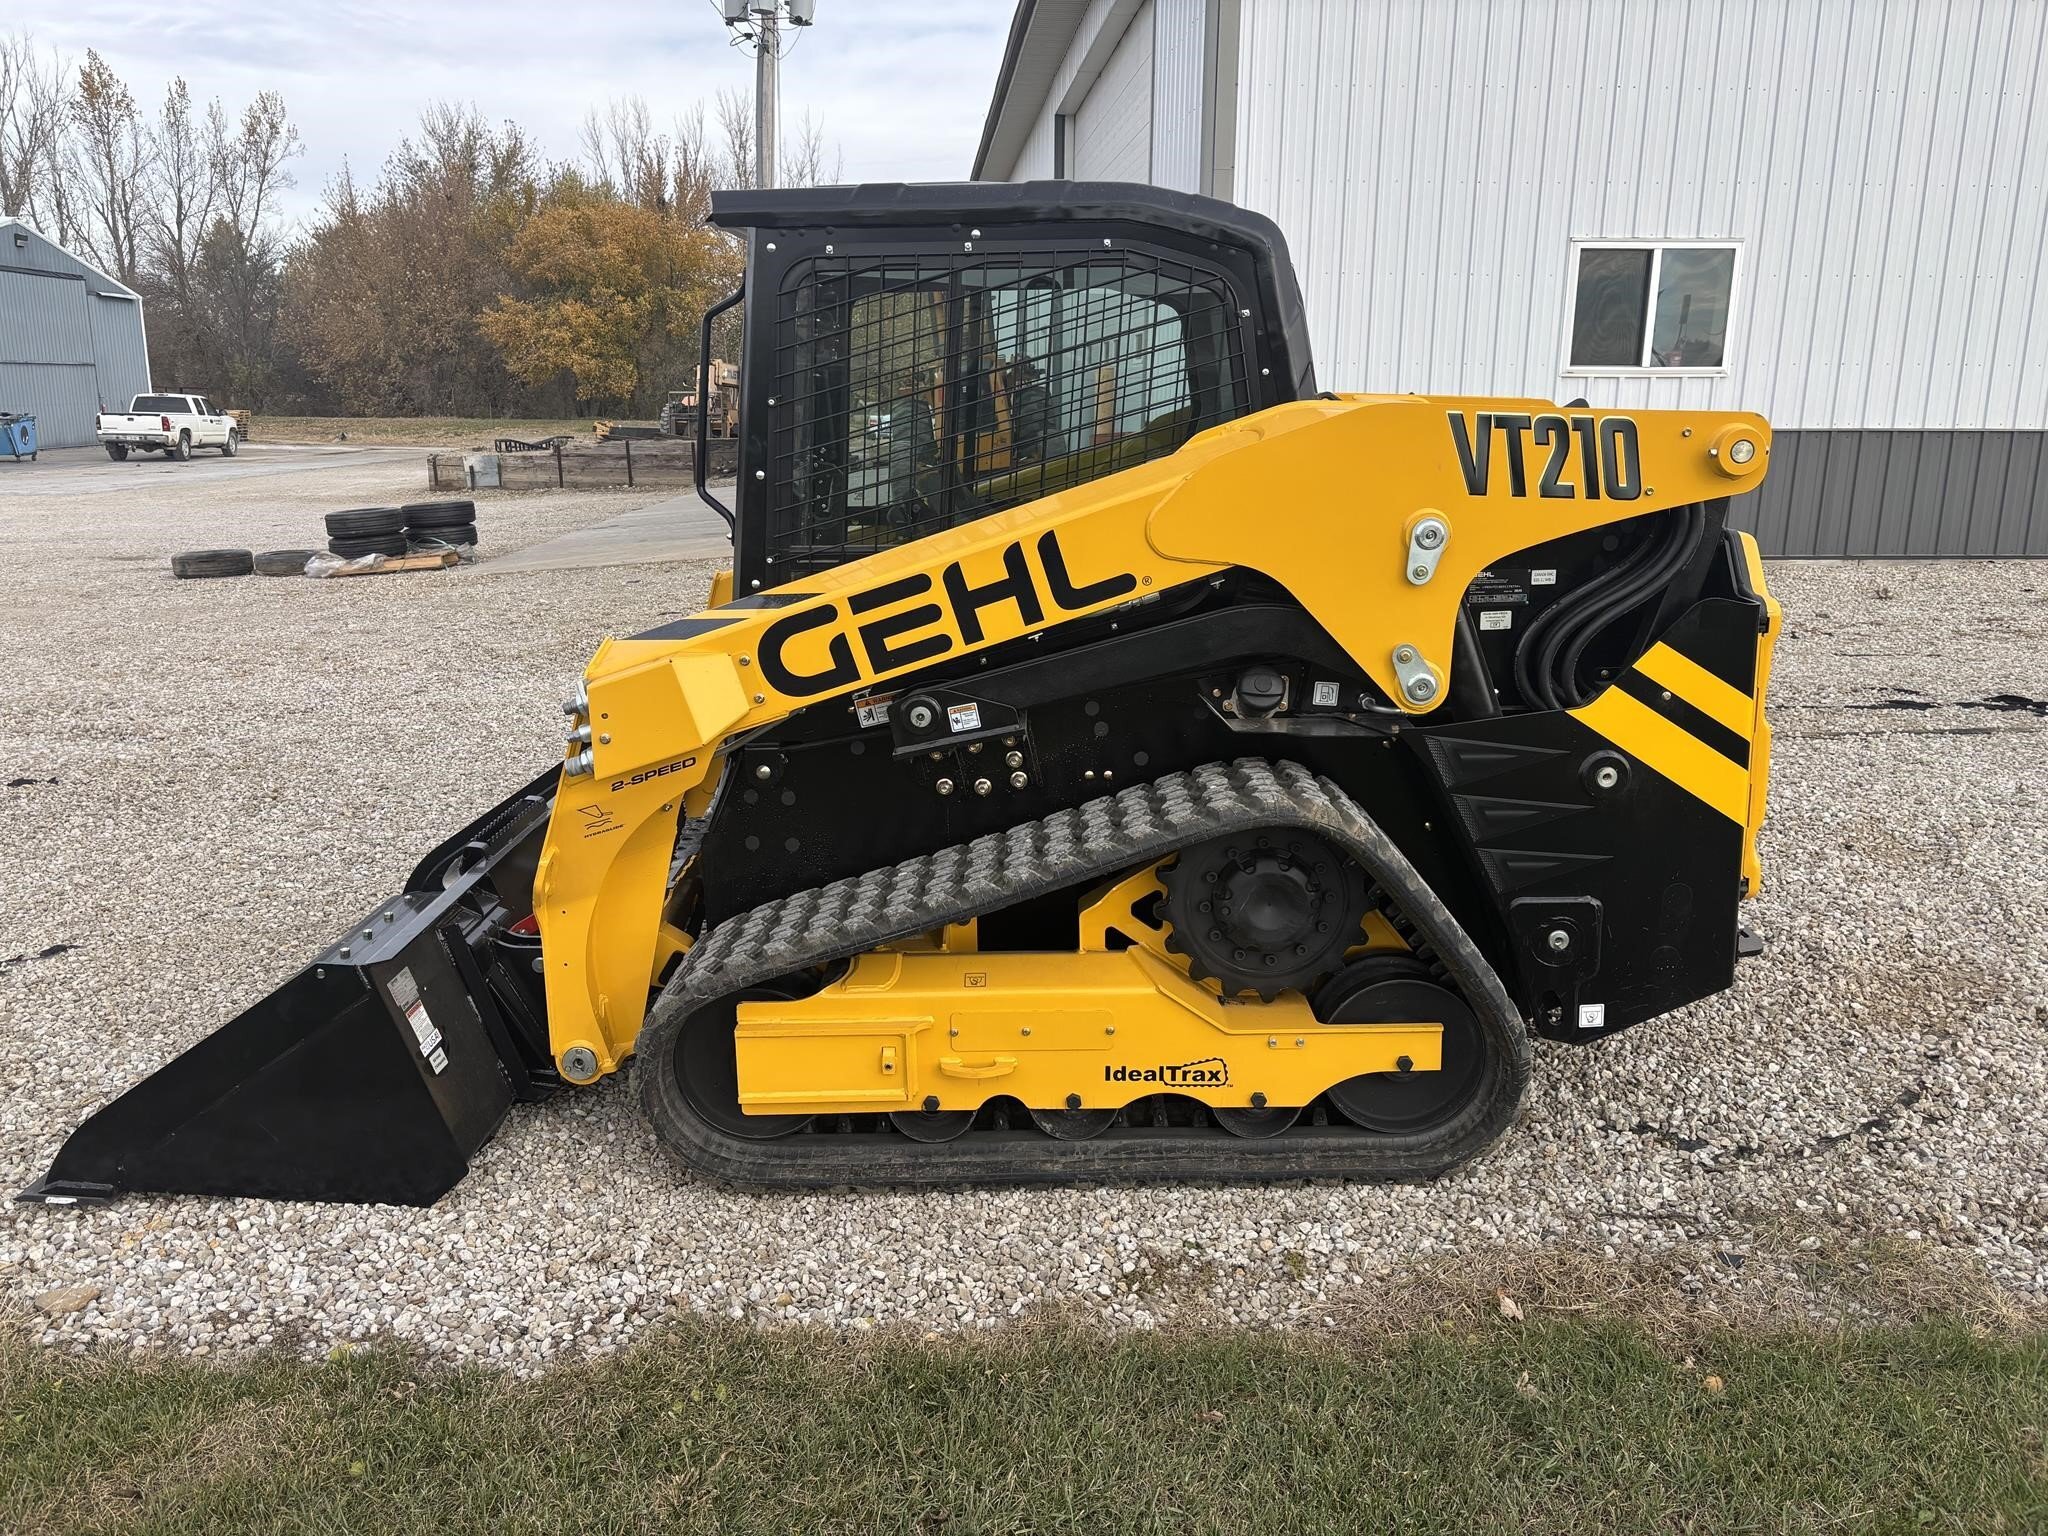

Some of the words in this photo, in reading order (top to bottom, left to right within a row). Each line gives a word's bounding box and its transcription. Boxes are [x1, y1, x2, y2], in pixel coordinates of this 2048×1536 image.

[1446, 410, 1641, 500] VT210
[758, 530, 1137, 697] GEHL
[611, 756, 697, 792] 2-SPEED
[1105, 1064, 1222, 1082] IdealTrax
